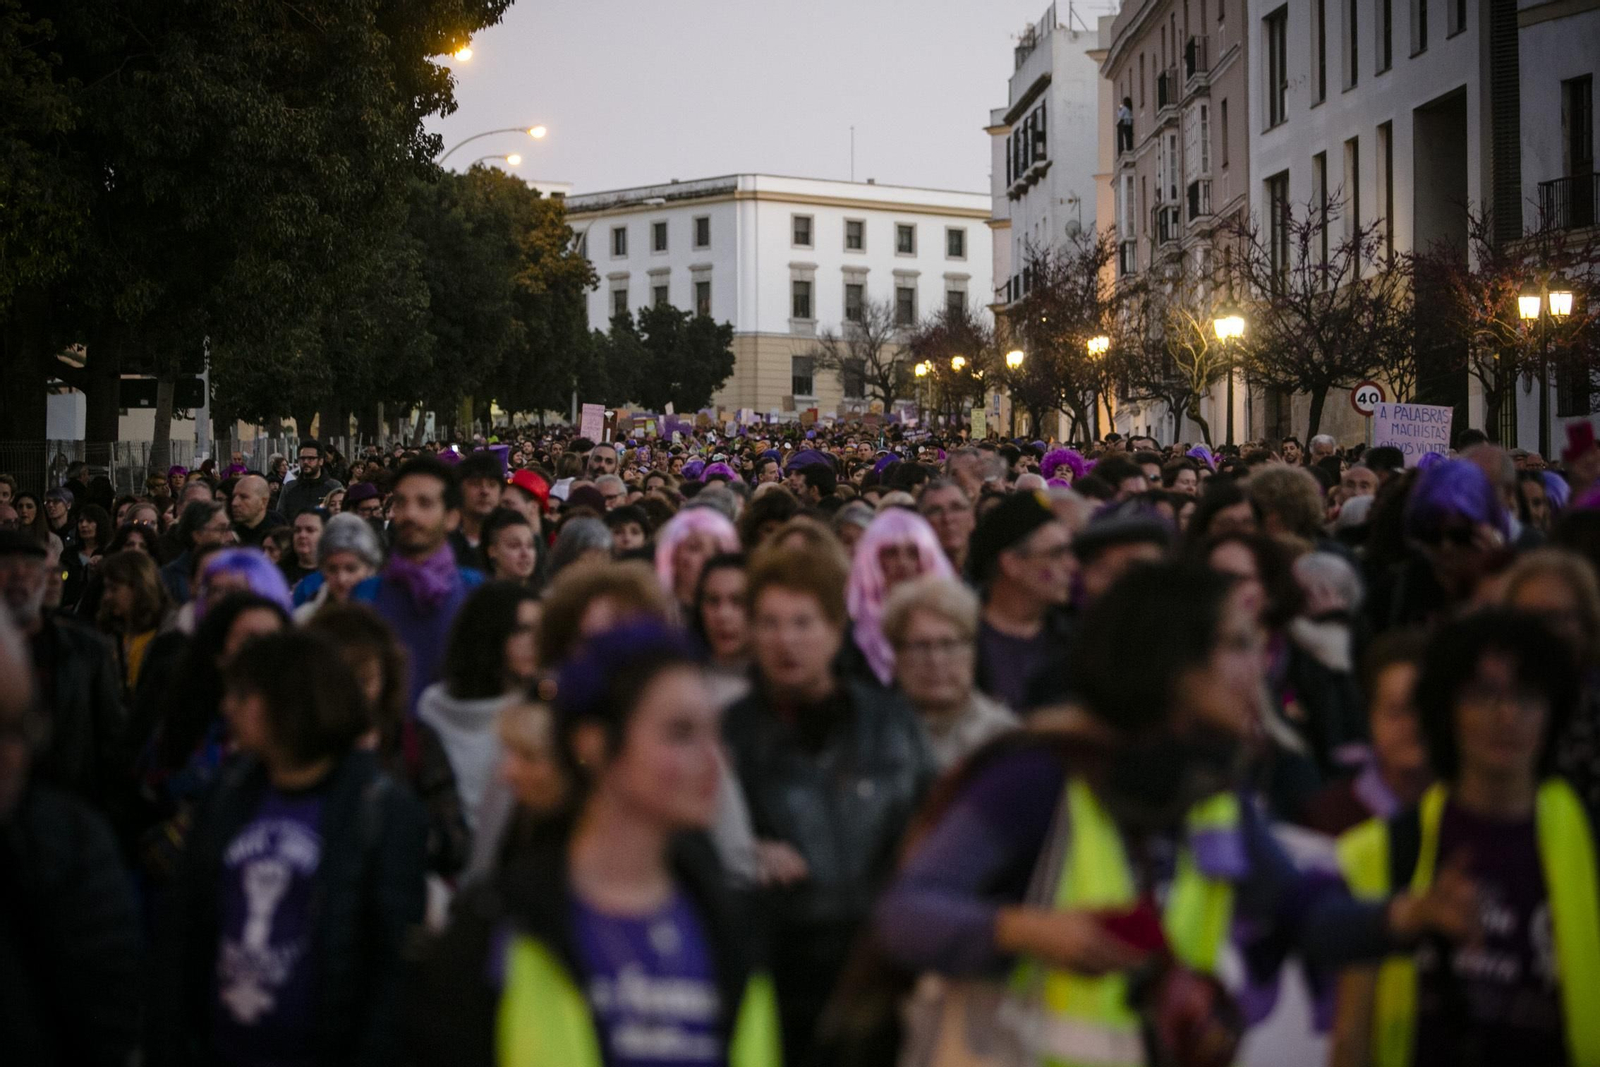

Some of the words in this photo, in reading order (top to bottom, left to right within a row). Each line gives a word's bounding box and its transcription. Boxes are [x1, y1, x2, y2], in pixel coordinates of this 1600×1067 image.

[1357, 392, 1379, 405] 40
[1380, 405, 1387, 420] A
[1393, 405, 1450, 424] PALABRAS
[1391, 423, 1447, 441] MACHISTAS
